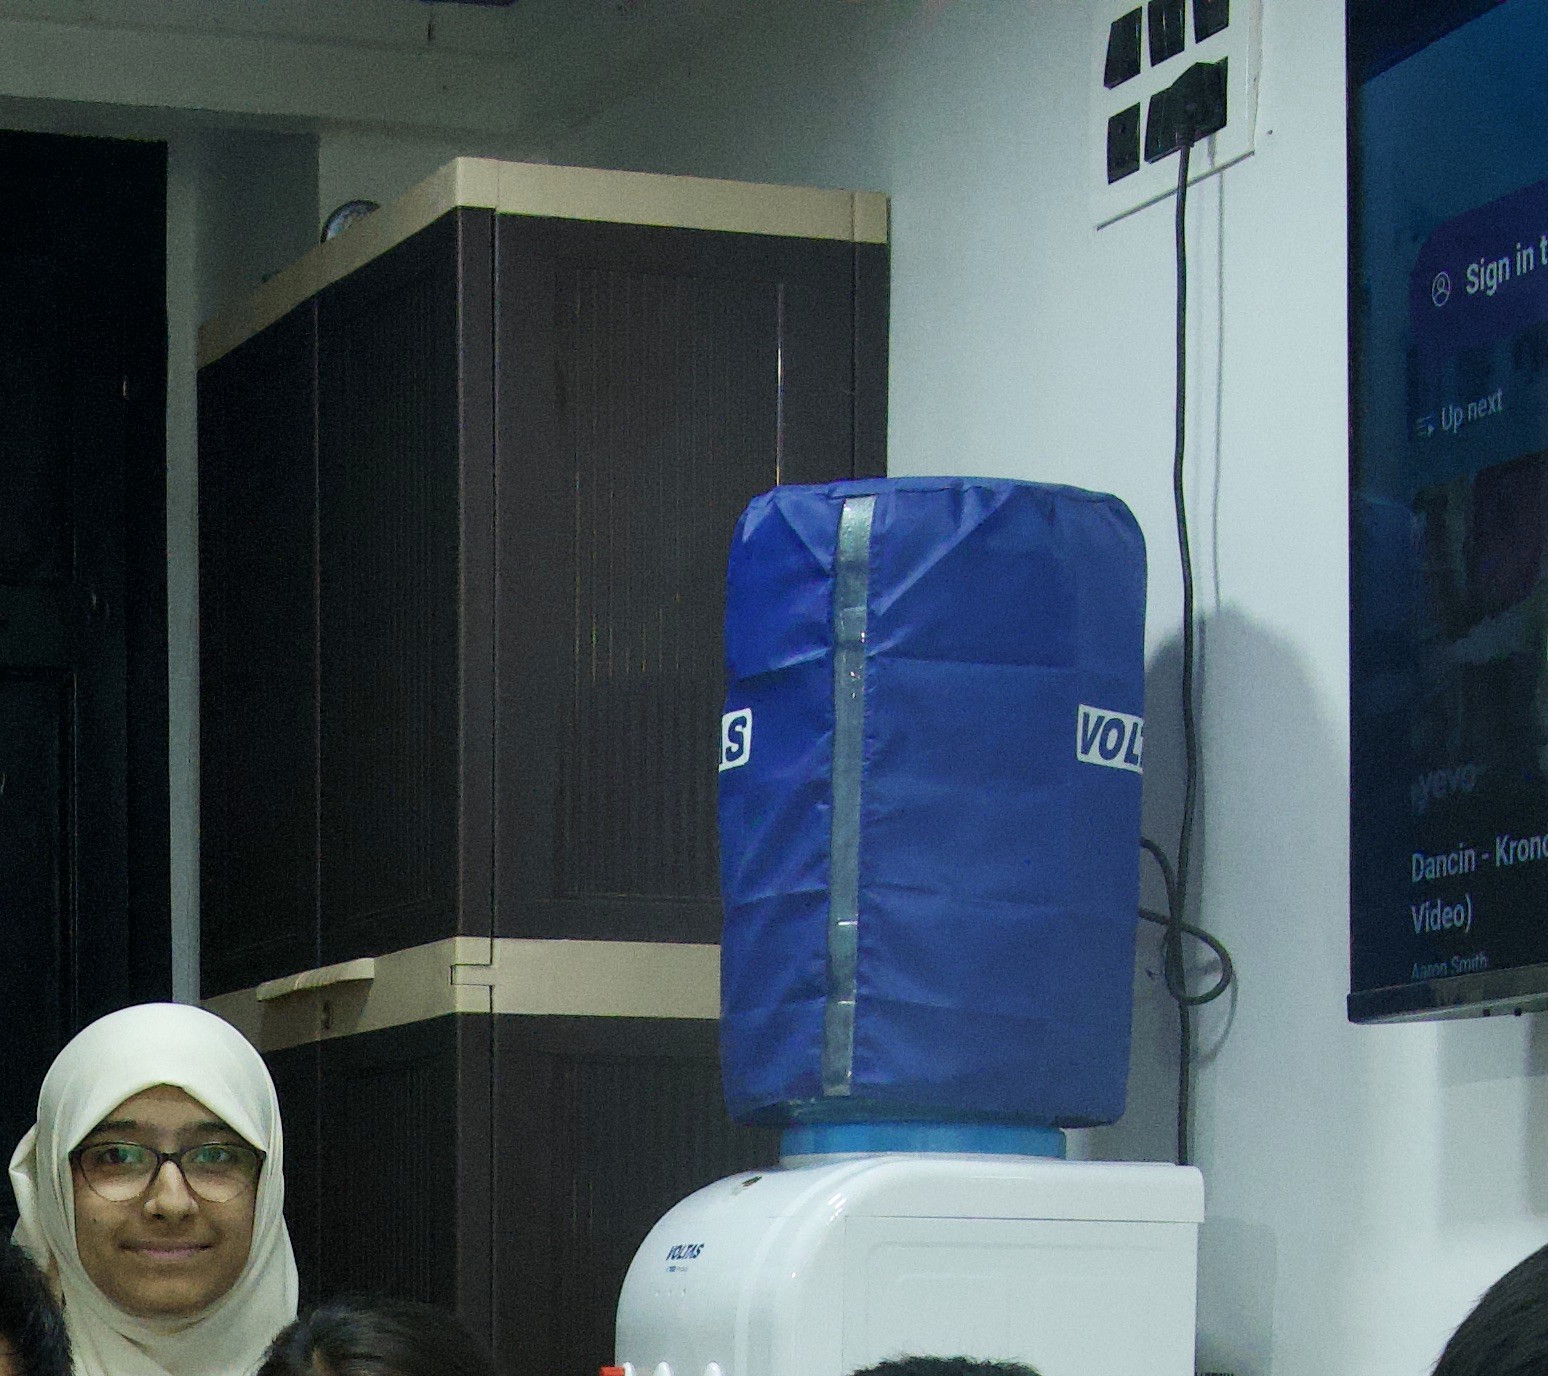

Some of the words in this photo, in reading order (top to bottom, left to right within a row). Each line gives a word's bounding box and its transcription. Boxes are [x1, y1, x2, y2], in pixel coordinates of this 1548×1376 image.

[1466, 255, 1510, 296] Sign
[1515, 243, 1534, 276] in
[1441, 403, 1463, 434] Up
[1467, 389, 1503, 424] next
[1080, 711, 1144, 767] VOL
[1412, 842, 1477, 883] Dancin
[1412, 893, 1474, 934] Video)
[665, 1243, 705, 1261] VOLTAS
